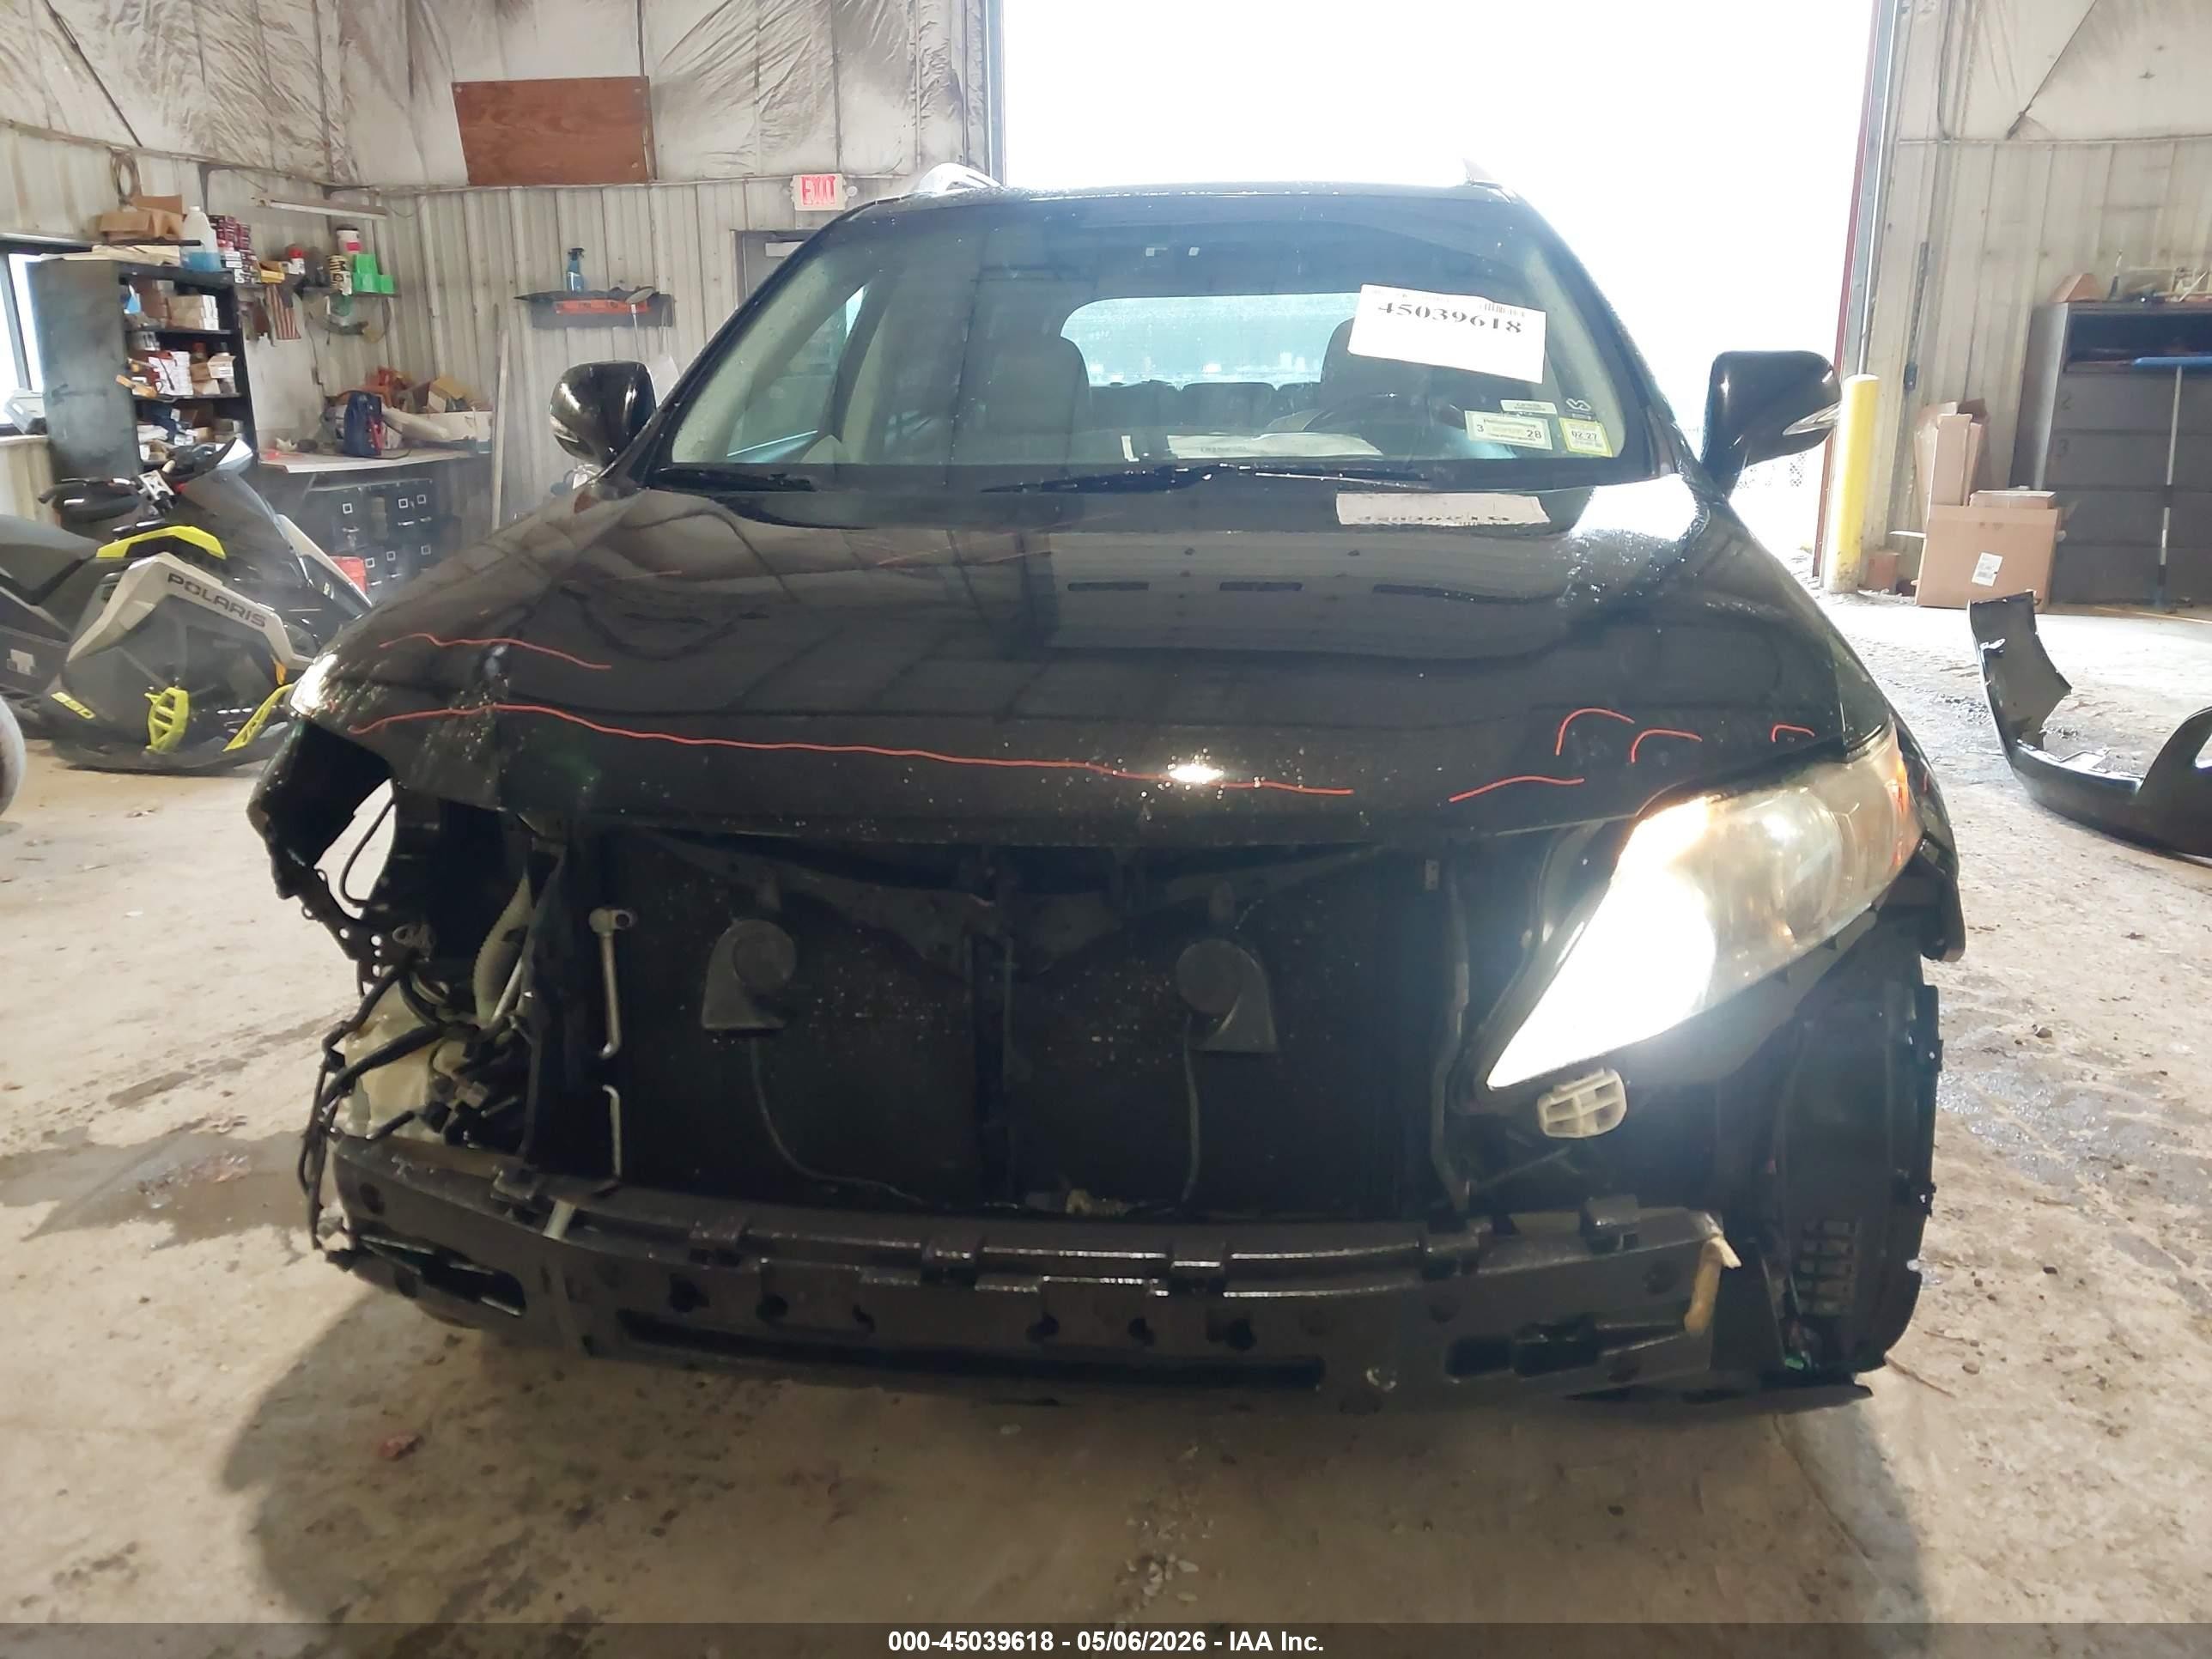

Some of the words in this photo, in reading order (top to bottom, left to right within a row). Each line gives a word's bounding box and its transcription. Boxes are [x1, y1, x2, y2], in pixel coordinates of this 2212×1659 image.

[800, 175, 836, 205] EXIT
[1377, 302, 1522, 333] 45039618
[1526, 429, 1542, 439] 28
[167, 572, 267, 629] POLARIS
